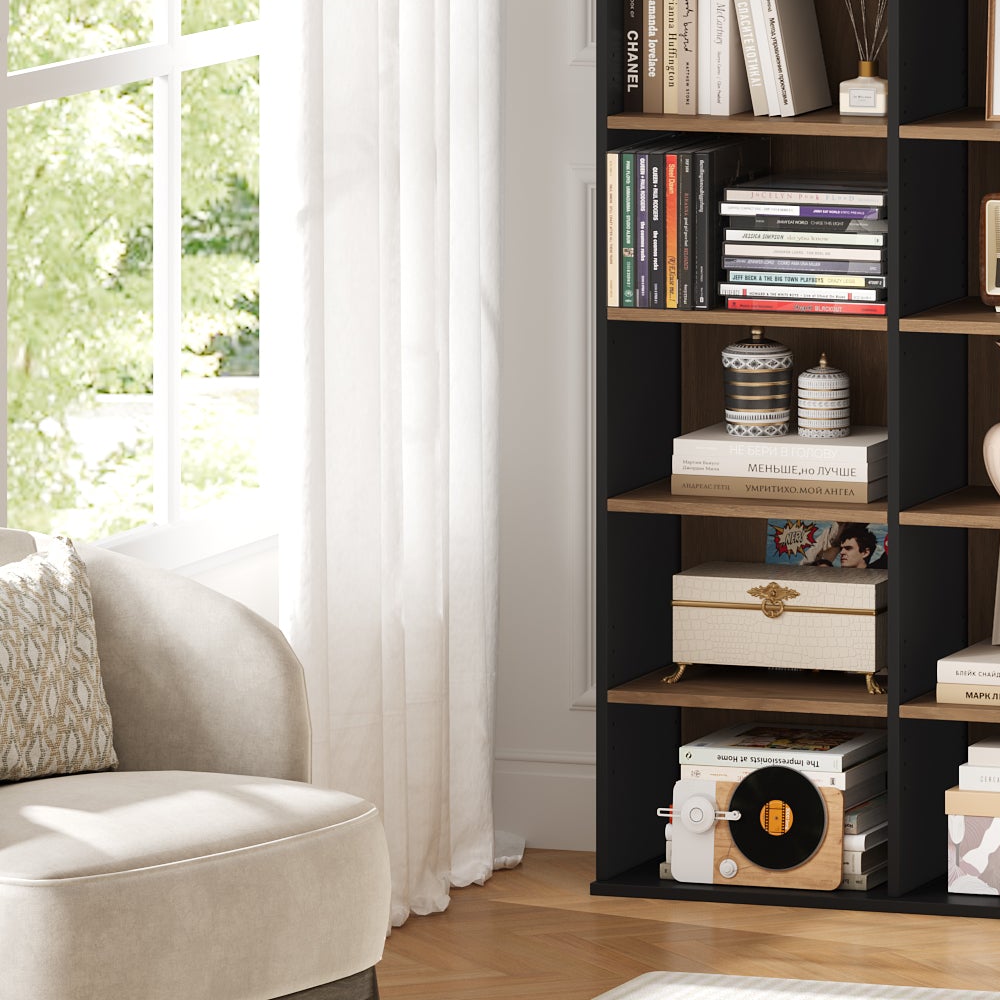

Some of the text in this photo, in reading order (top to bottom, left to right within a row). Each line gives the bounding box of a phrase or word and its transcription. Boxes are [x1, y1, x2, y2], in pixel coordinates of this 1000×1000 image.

[648, 0, 659, 77] amanda lovelace
[737, 1, 762, 87] СПАСИТЕ КОТИКА!
[627, 30, 639, 93] CHANEL
[666, 33, 678, 88] Huffington
[744, 274, 757, 282] BECK
[817, 465, 857, 477] ЛУЧШЕ
[824, 487, 855, 497] АНГЕЛ
[965, 691, 991, 701] МАРК
[717, 754, 738, 762] Home
[749, 756, 804, 767] Impressionists
[806, 759, 820, 768] The
